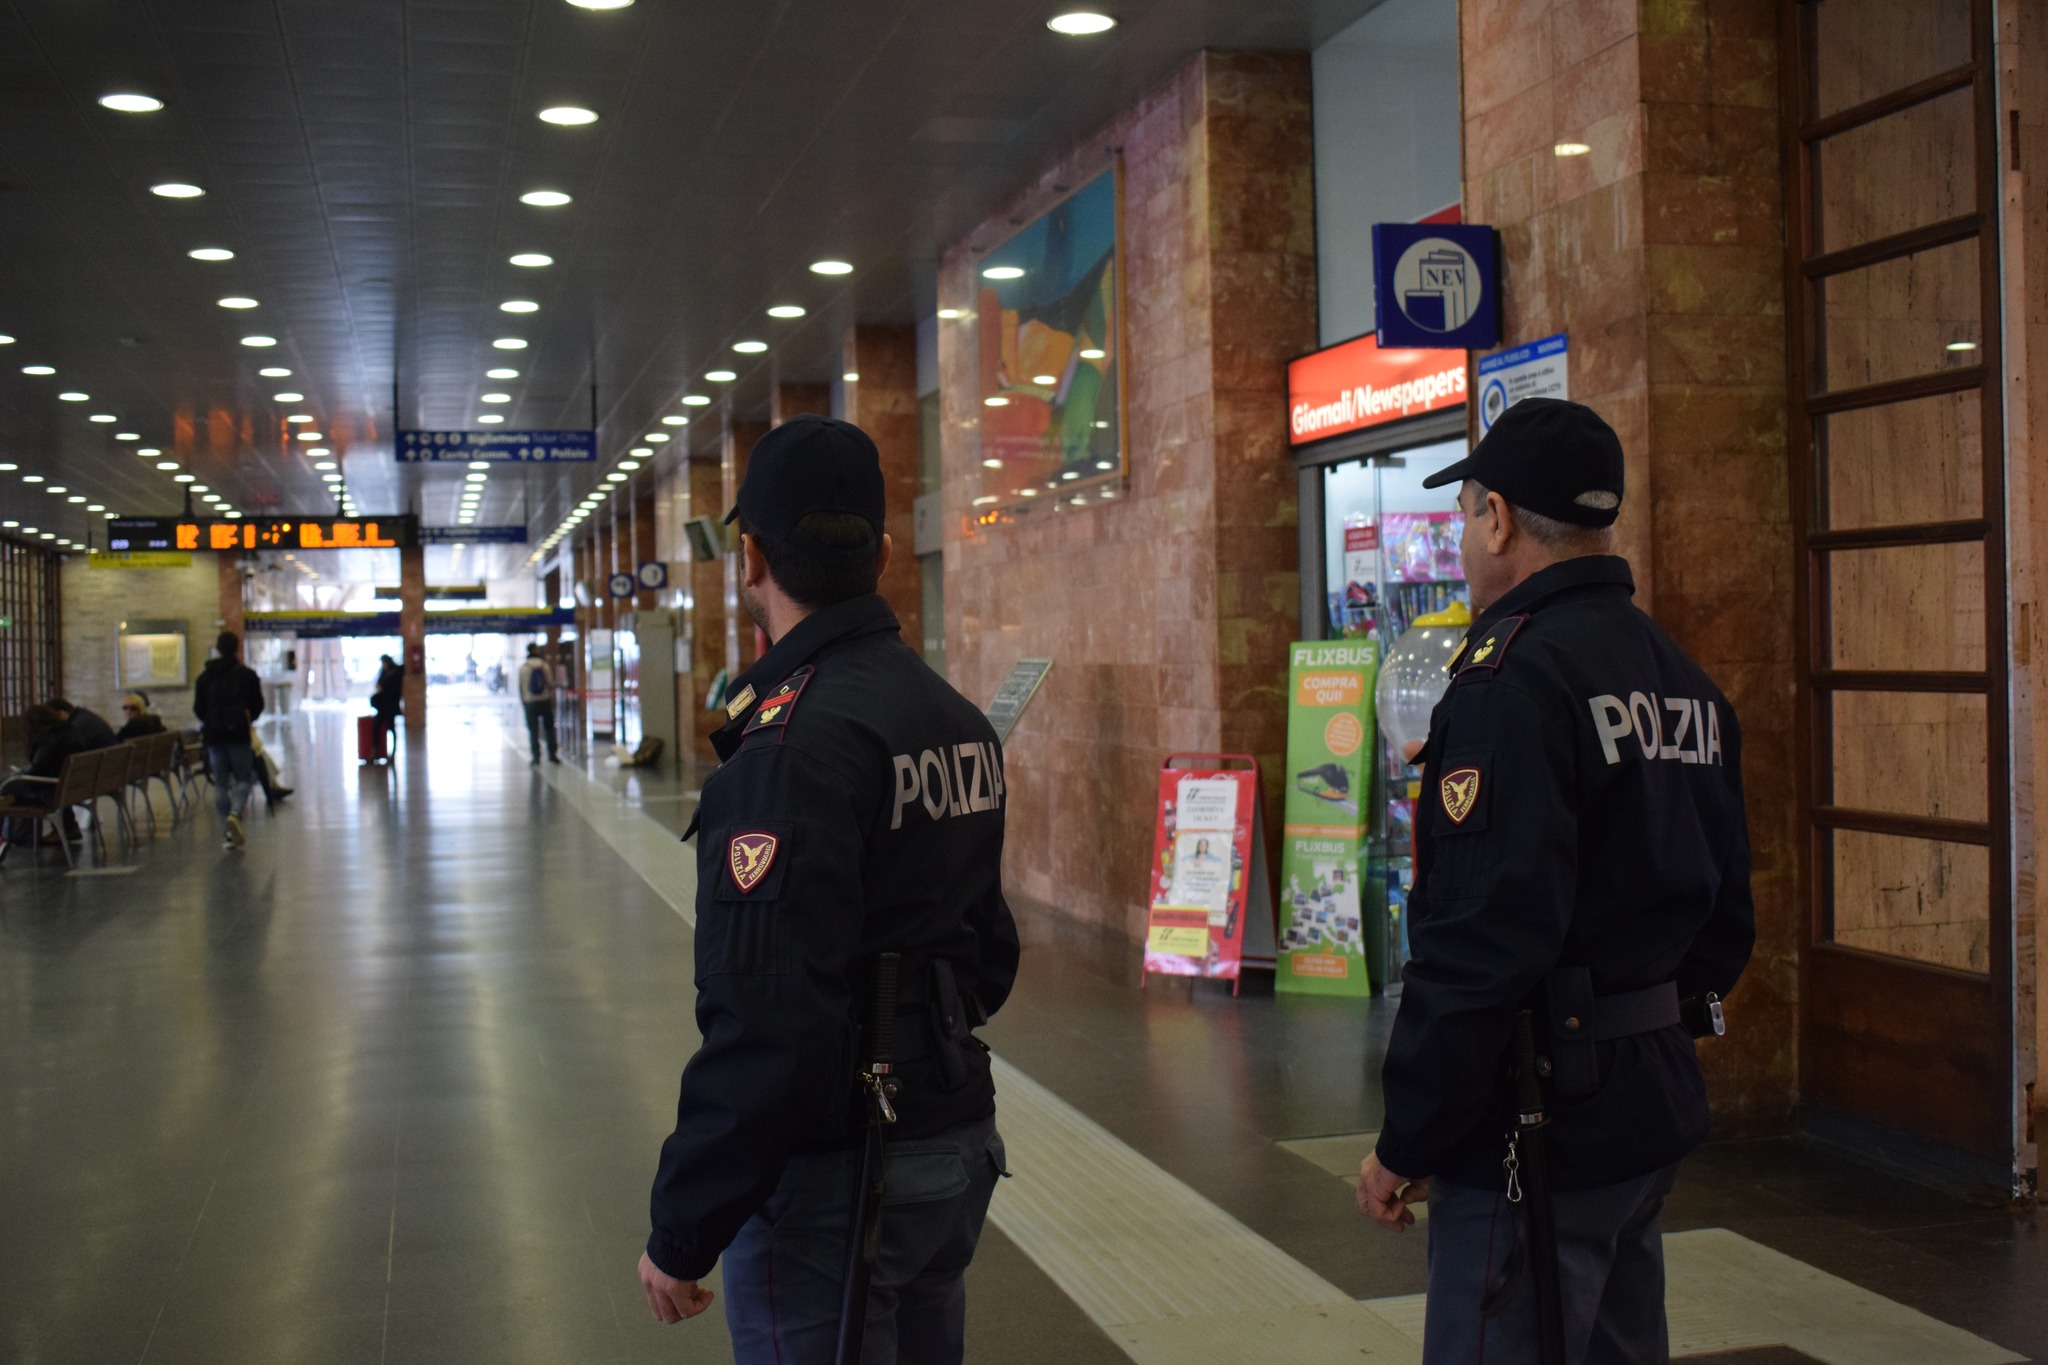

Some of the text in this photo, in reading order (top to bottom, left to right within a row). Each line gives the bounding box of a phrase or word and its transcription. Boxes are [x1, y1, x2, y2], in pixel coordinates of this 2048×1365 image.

[1291, 366, 1467, 436] Giornali/Newspapers
[1303, 676, 1359, 690] COMPRA
[1315, 690, 1344, 705] QUI!
[890, 741, 1004, 831] POLIZIA
[1444, 784, 1459, 815] POLIZIA
[1459, 776, 1477, 814] FERROVIARIA
[734, 846, 747, 881] POLIZIA
[749, 843, 773, 882] FERROVIARIA
